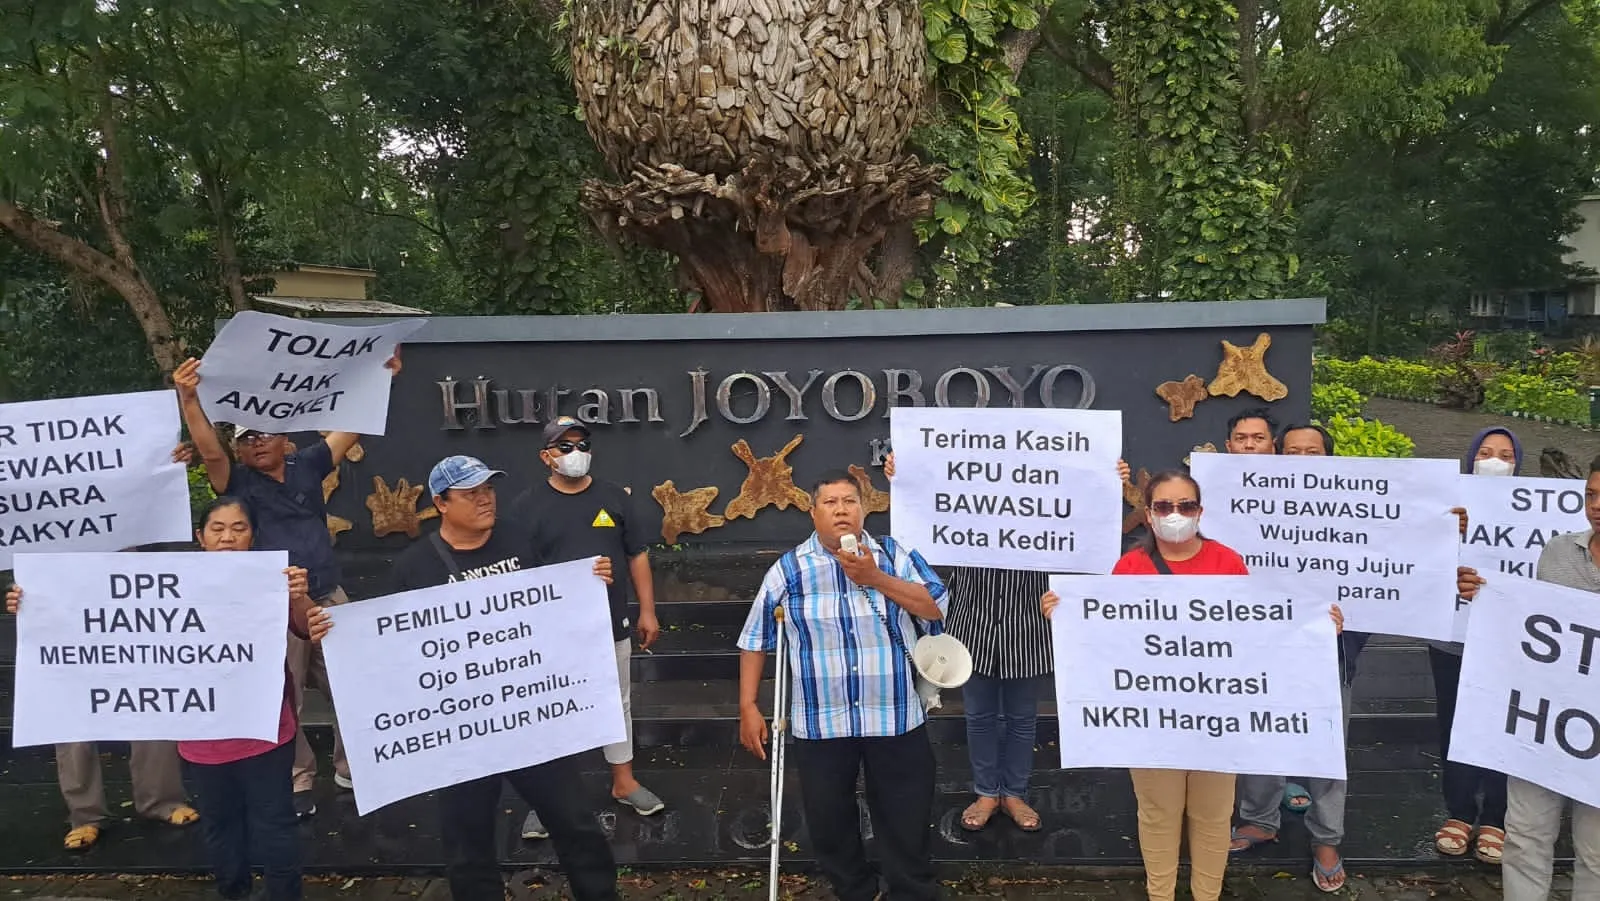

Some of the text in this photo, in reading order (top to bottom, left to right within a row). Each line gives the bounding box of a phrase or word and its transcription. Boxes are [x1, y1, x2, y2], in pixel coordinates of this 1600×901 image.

[267, 328, 382, 359] TOLAK
[270, 372, 339, 392] HAK
[216, 391, 344, 419] ANGKET
[436, 364, 1096, 438] Hutan JOYOBOYO
[26, 415, 126, 443] TIDAK
[920, 427, 1089, 452] Terima Kasih
[947, 461, 1059, 485] KPU dan
[1242, 472, 1388, 496] Kami Dukung
[0, 485, 106, 514] SUARA
[935, 493, 1071, 519] BAWASLU
[1231, 498, 1400, 520] KPU BAWASLU
[932, 525, 1075, 552] Kota Kediri
[1260, 524, 1368, 545] Wujudkan
[1241, 551, 1415, 578] milu yang Jujur
[110, 573, 181, 599] DPR
[84, 608, 206, 633] HANYA
[376, 583, 562, 636] PEMILU JURDIL
[1083, 598, 1293, 622] Pemilu Selesai
[40, 643, 254, 665] MEMENTINGKAN
[420, 621, 532, 660] Ojo Pecah
[1144, 634, 1232, 658] Salam
[418, 649, 542, 692] Ojo Bubrah
[1114, 668, 1268, 695] Demokrasi
[90, 687, 215, 713] PARTAI
[374, 674, 587, 731] Goro-Goro Pemilu...
[374, 698, 595, 763] KABEH DULUR NDA...
[1082, 706, 1308, 738] NKRI Harga Mati
